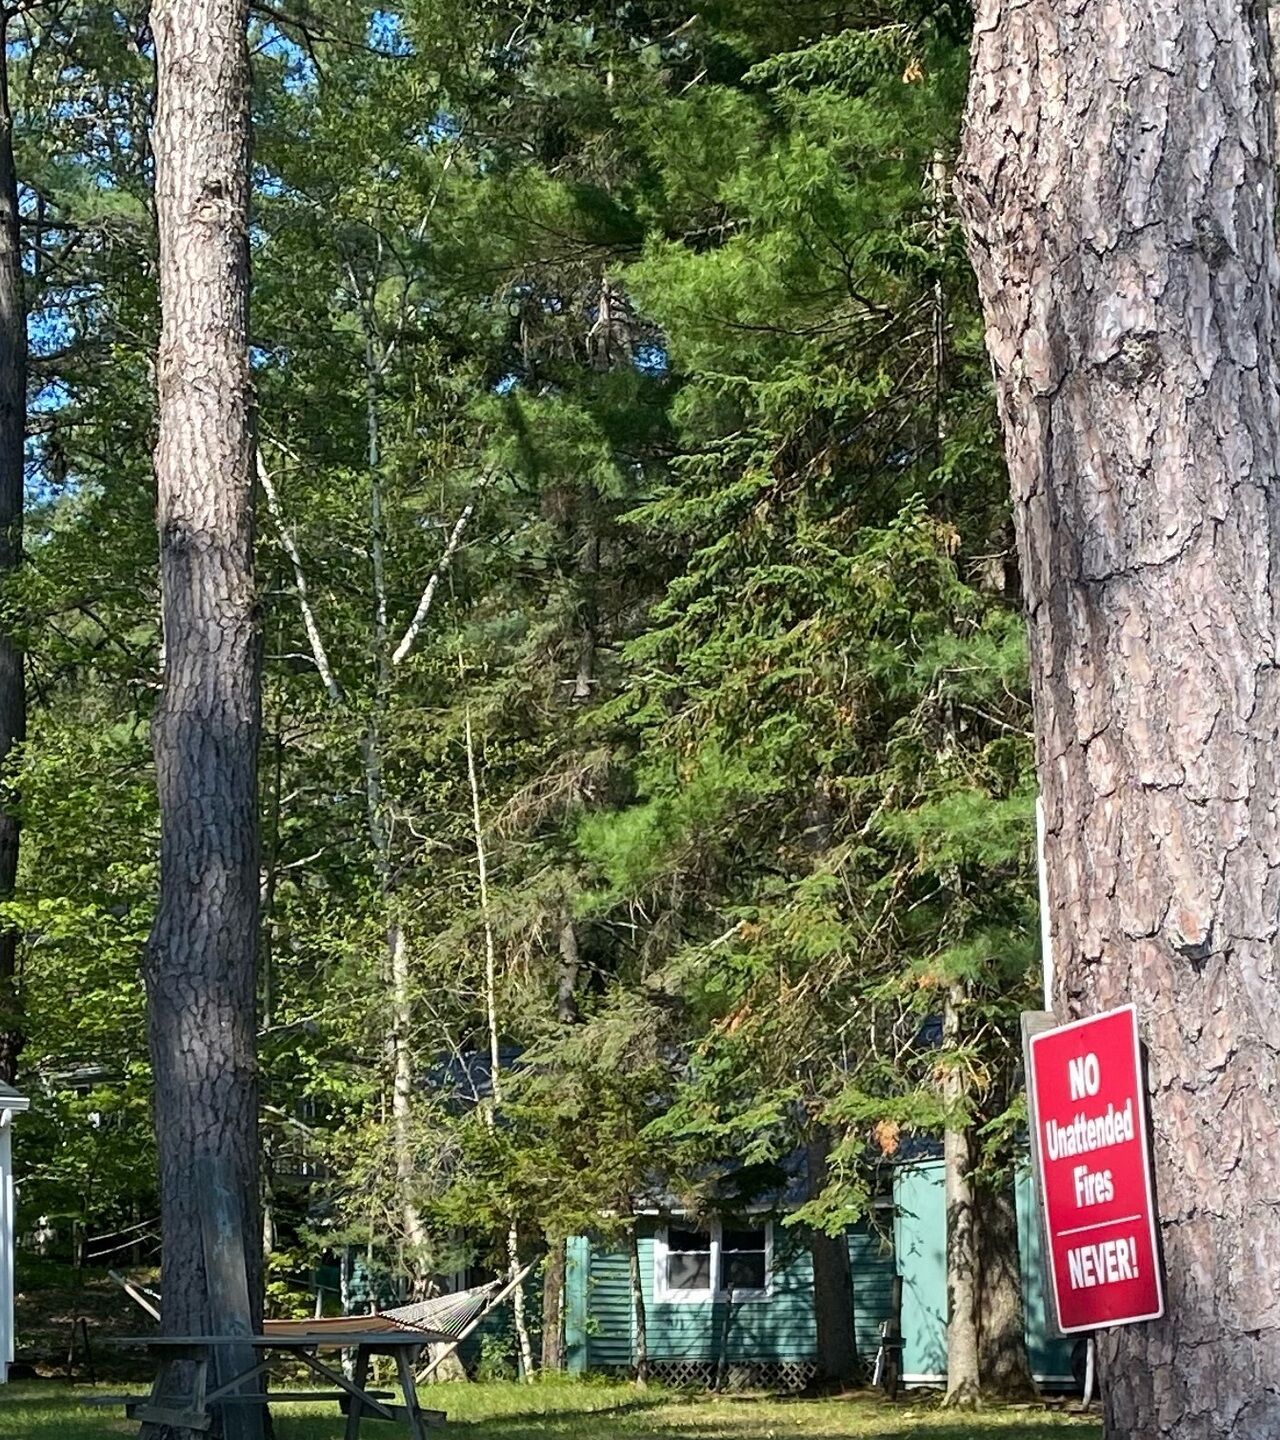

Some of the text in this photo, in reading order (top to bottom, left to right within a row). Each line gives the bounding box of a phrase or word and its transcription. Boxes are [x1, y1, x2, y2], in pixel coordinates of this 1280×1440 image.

[1068, 1052, 1100, 1101] NO
[1045, 1097, 1134, 1161] Unattended
[1073, 1164, 1114, 1208] Fires
[1067, 1236, 1139, 1290] NEVER!
